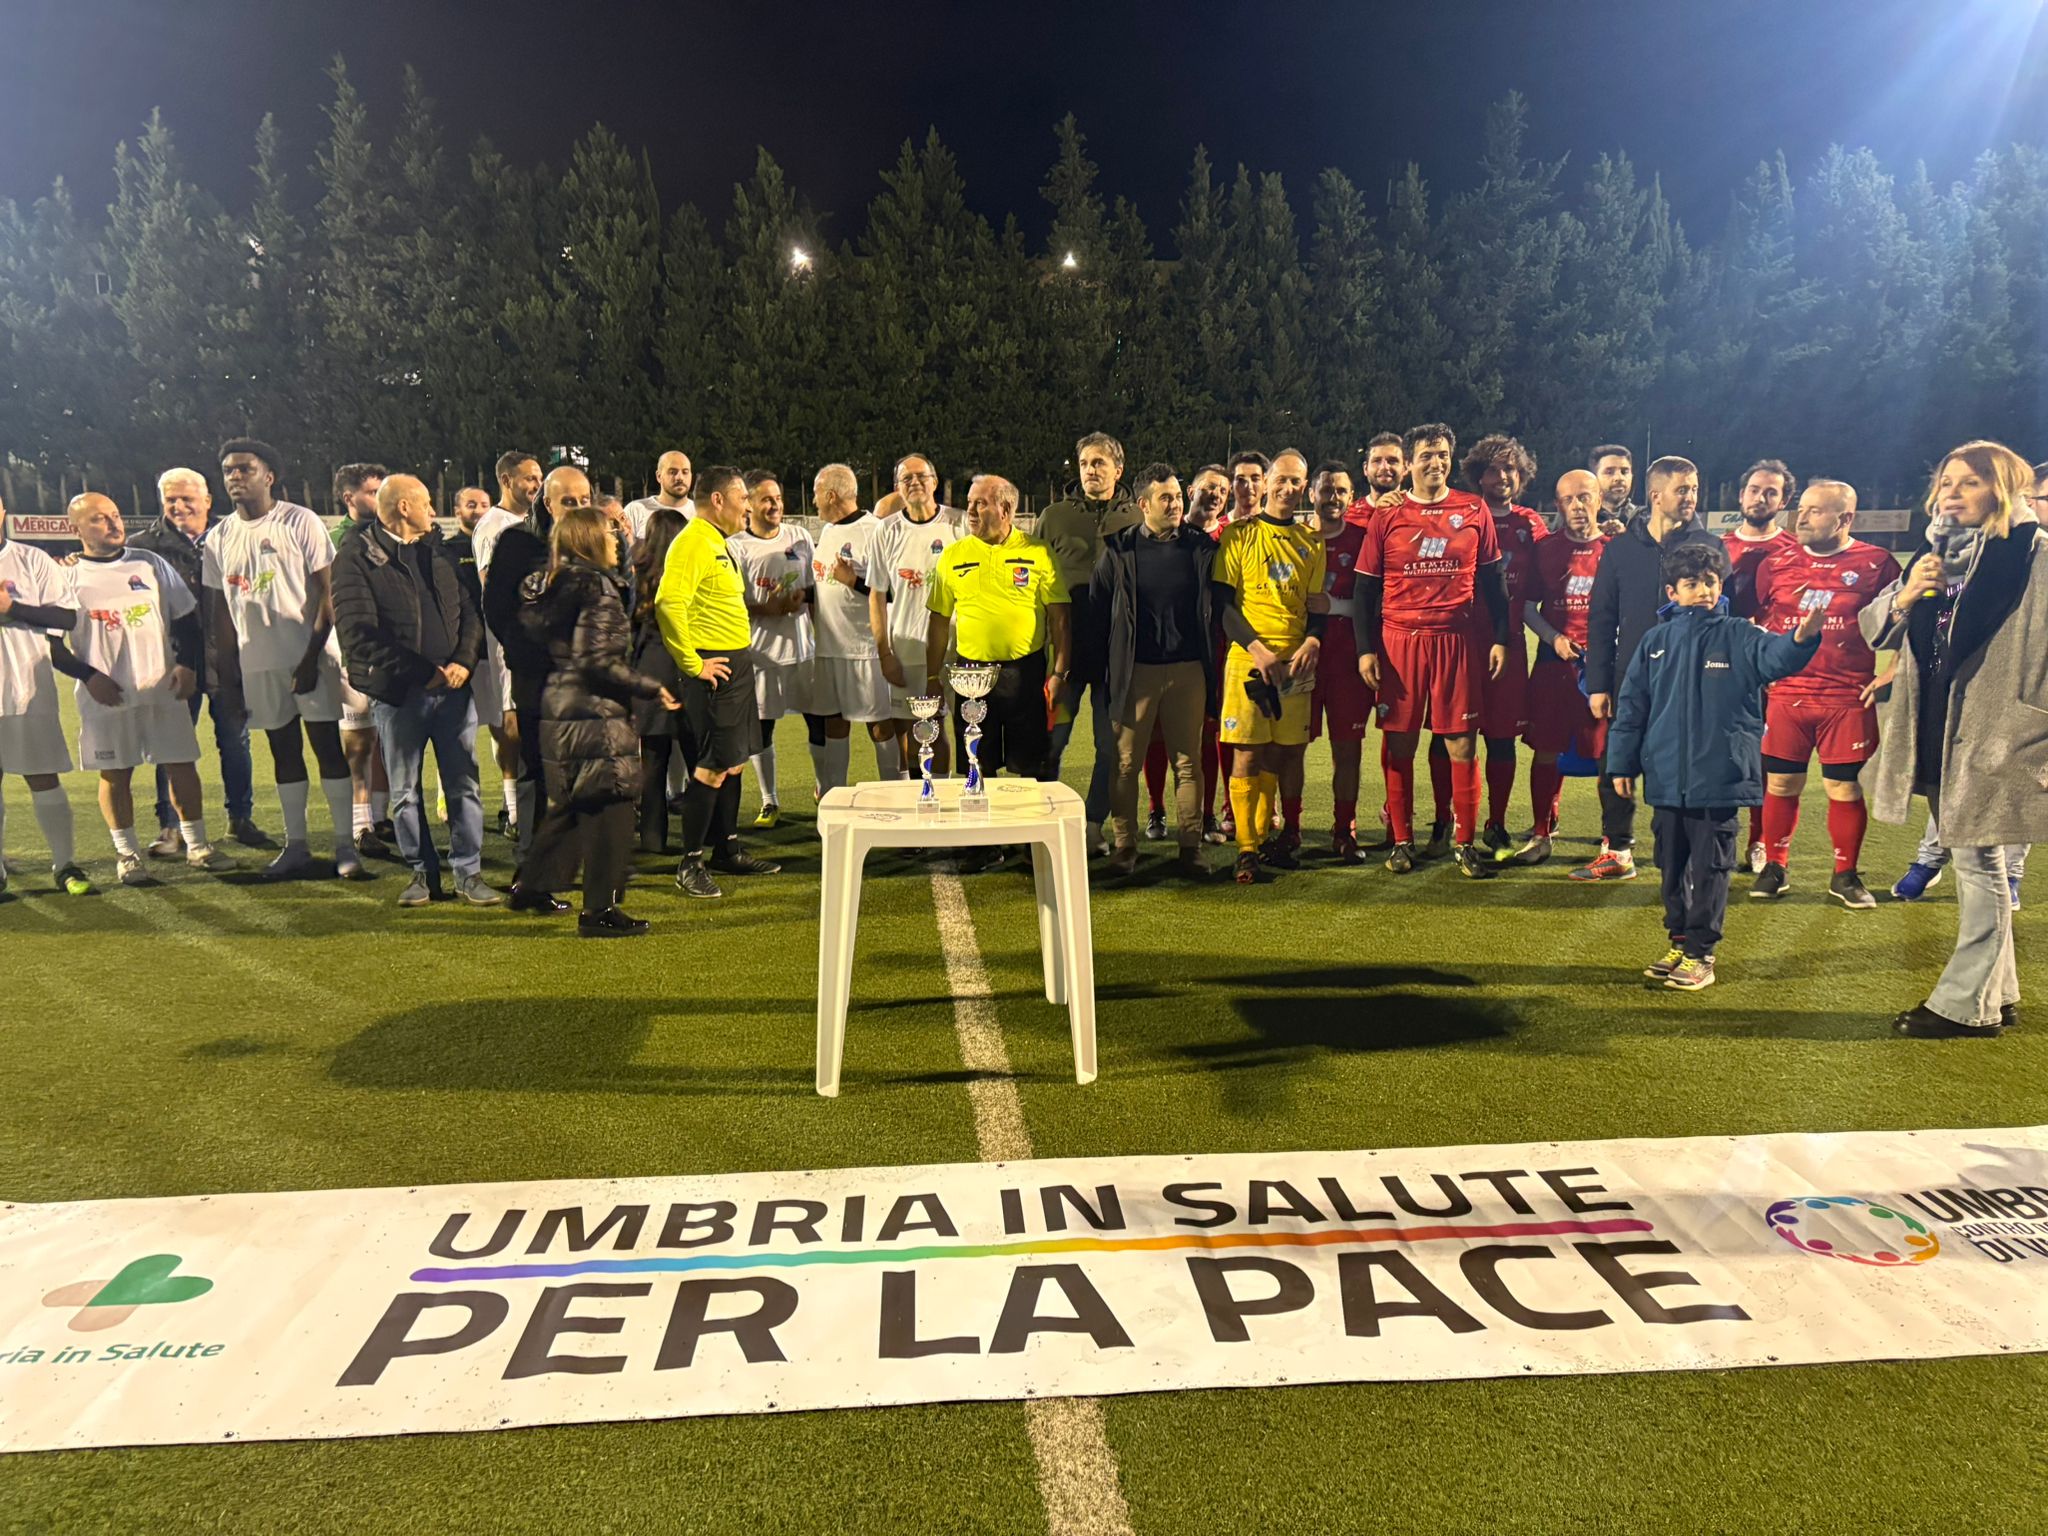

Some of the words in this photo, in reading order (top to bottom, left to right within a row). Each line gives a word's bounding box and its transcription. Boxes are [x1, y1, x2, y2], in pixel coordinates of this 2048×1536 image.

[1704, 660, 1729, 668] Joma
[429, 1193, 959, 1259] UMBRIA
[1000, 1184, 1126, 1234] IN
[1162, 1167, 1634, 1228] SALUTE
[1969, 1237, 2028, 1263] DI
[335, 1277, 787, 1387] PER
[879, 1263, 1135, 1358] LA
[1186, 1240, 1752, 1343] PACE
[51, 1346, 92, 1364] in
[97, 1340, 226, 1362] Salute
